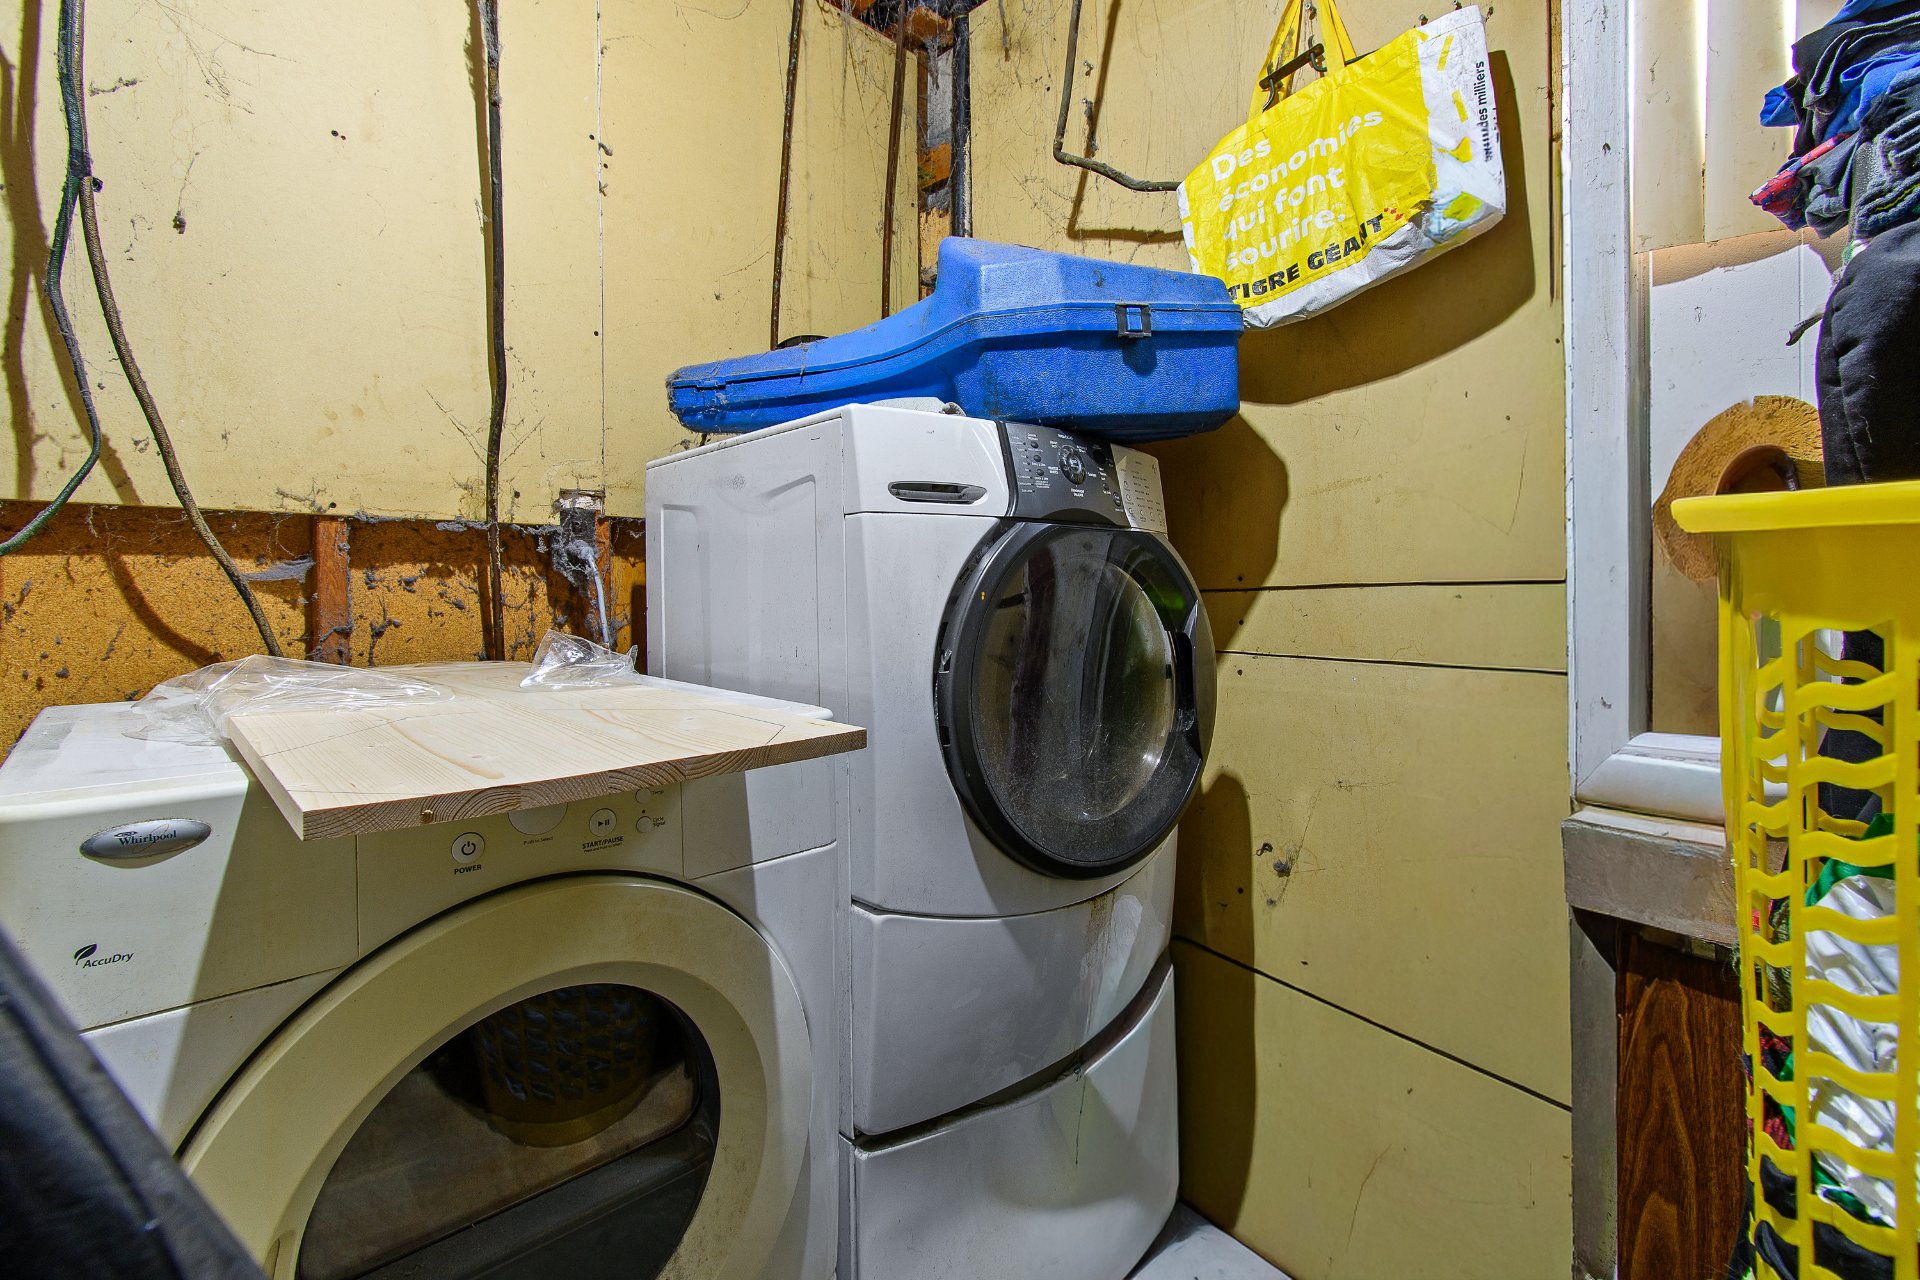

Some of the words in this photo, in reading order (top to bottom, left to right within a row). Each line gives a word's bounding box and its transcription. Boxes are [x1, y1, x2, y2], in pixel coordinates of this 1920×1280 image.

[1475, 61, 1488, 105] milliers
[1211, 137, 1271, 182] Des
[1219, 110, 1383, 213] économies
[1274, 165, 1346, 217] font
[1228, 263, 1300, 300] TIGRE
[1307, 213, 1384, 271] GÉANT
[118, 829, 177, 846] Whirlpool
[582, 835, 624, 850] START/PAUSE
[453, 864, 482, 875] POWER
[82, 952, 135, 969] AccuDry
